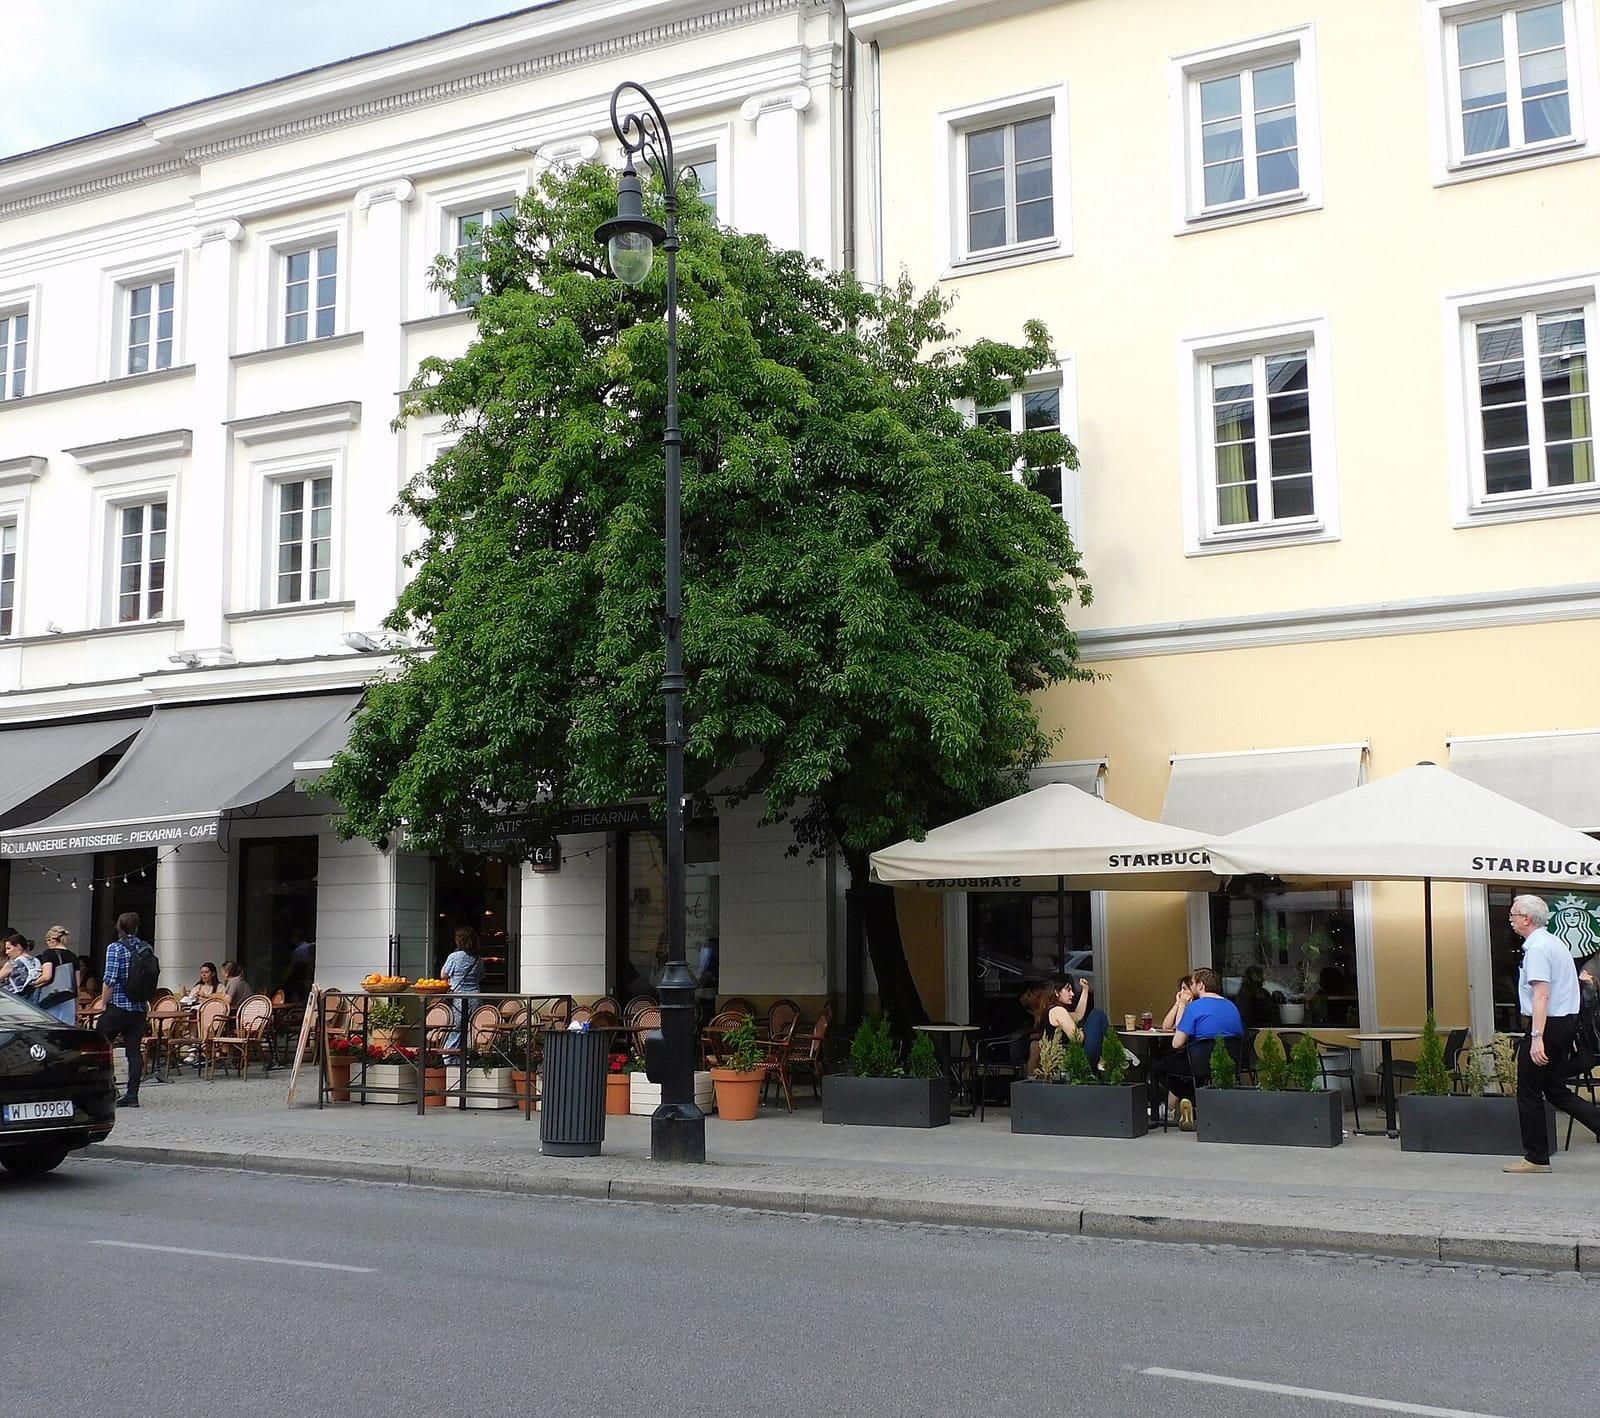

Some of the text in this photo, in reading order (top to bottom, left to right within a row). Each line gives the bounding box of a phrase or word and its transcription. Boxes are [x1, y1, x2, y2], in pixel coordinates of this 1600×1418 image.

[571, 810, 639, 827] PIEKARNIA
[1, 838, 67, 854] BOULANGERIE
[69, 833, 123, 849] PATISSERIE
[130, 828, 182, 843] PIEKARNIA
[189, 821, 217, 837] CAFÉ
[535, 847, 553, 864] 64
[1109, 852, 1211, 867] STARBUCK
[12, 1101, 72, 1119] WI 099GK
